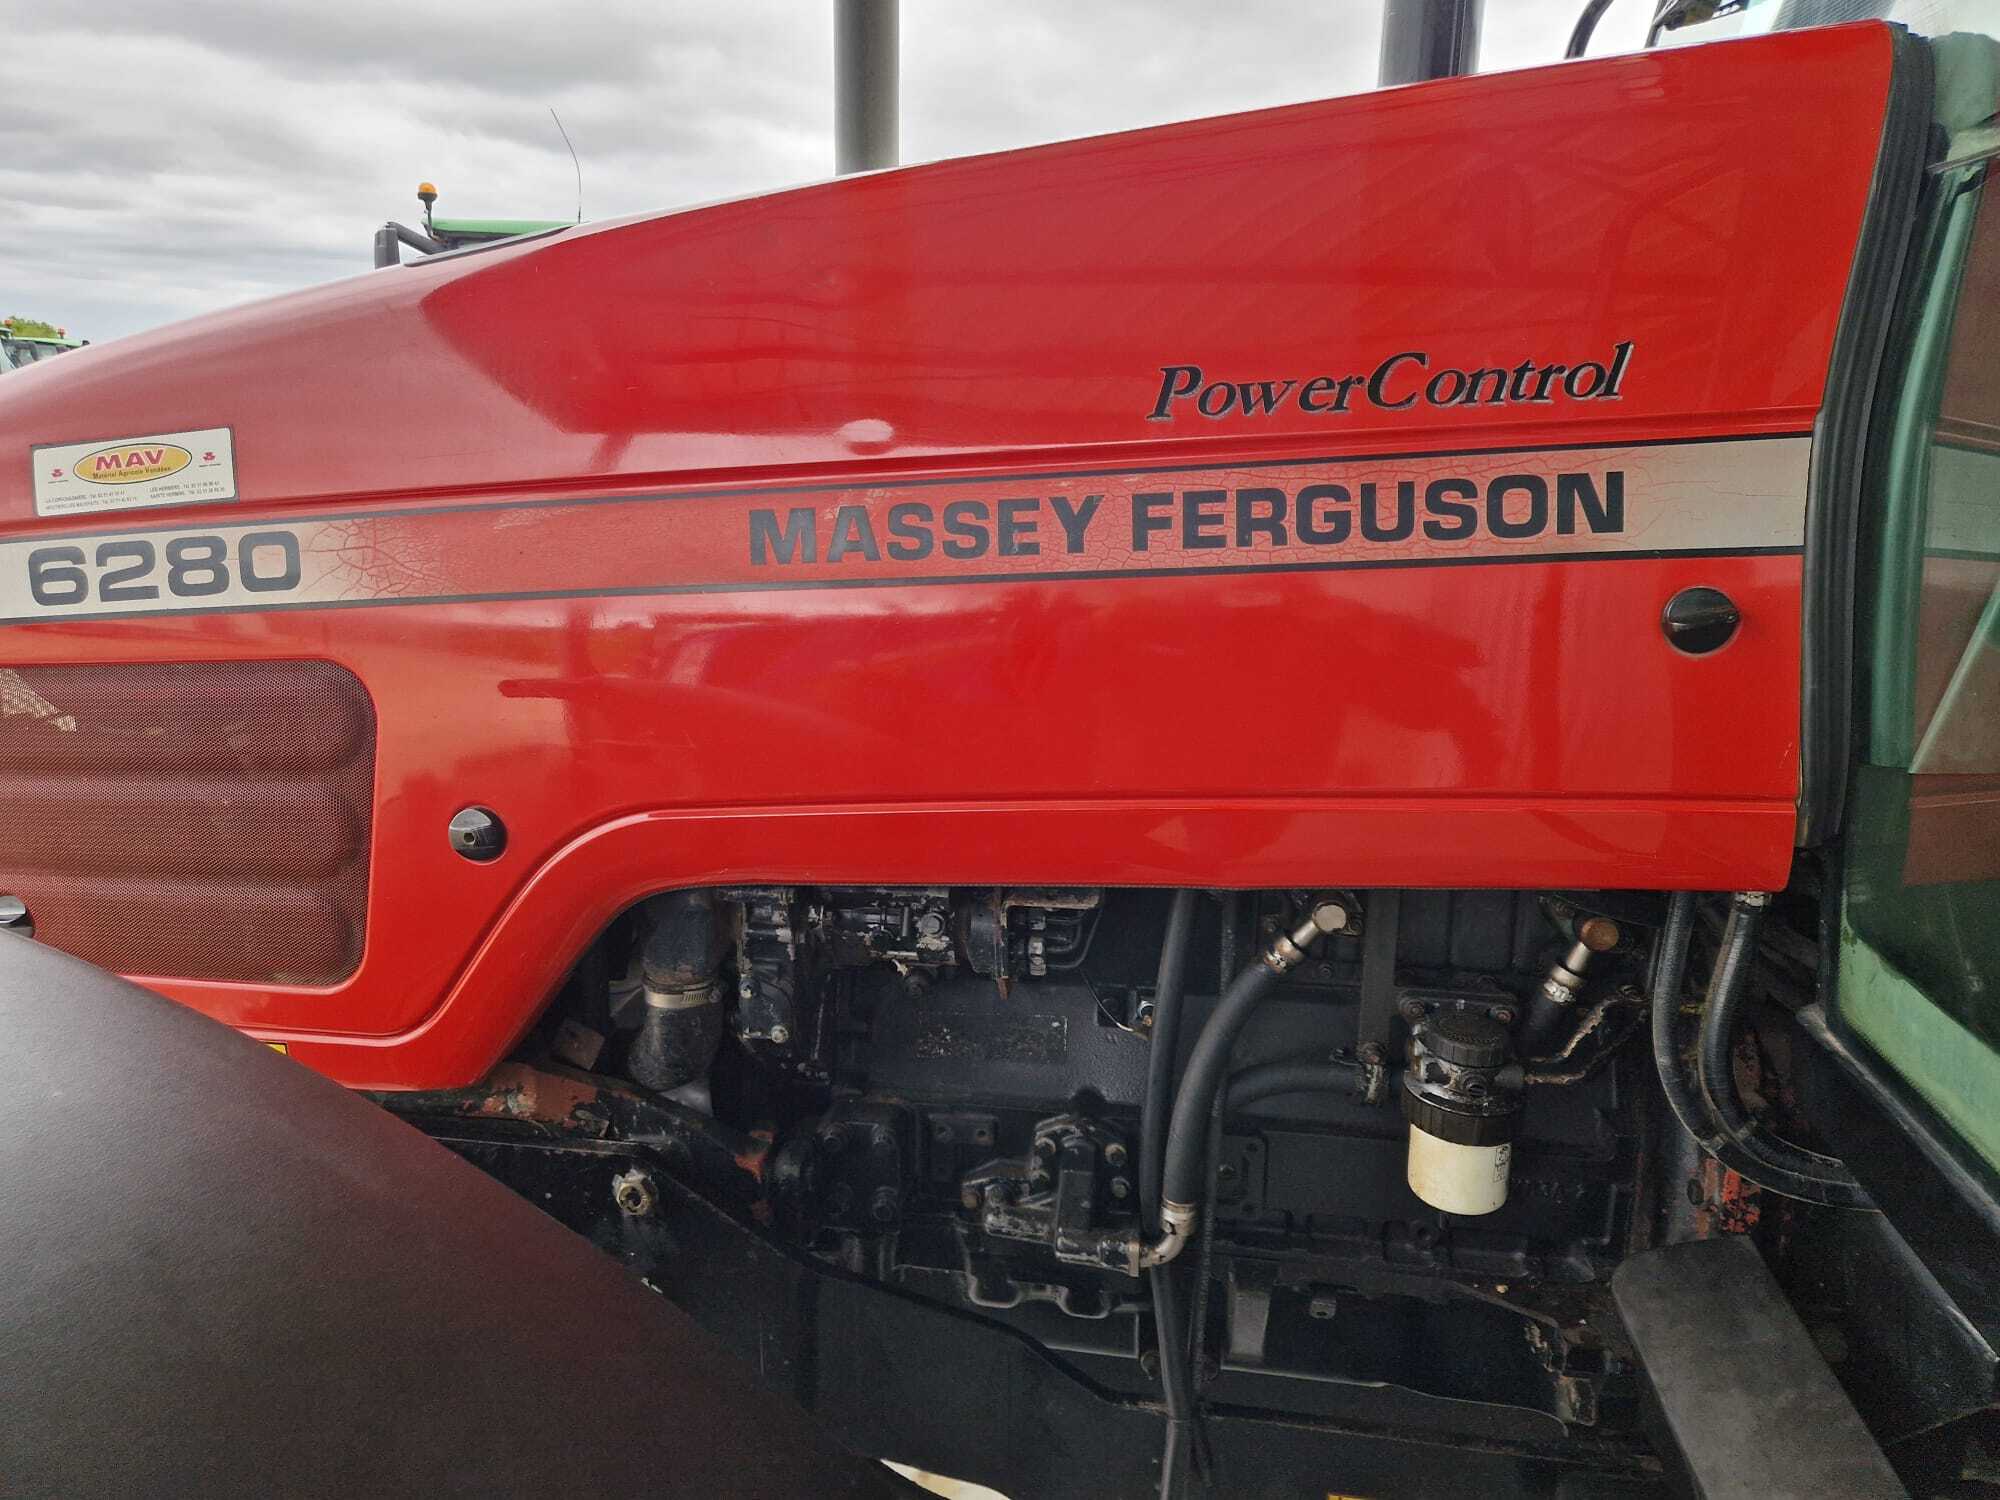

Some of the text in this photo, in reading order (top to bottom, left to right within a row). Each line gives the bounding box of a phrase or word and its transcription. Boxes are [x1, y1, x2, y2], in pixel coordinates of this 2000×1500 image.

[1146, 341, 1634, 423] PowerControl
[95, 448, 165, 472] MAV
[748, 471, 1625, 566] MASSEY FERGUSON
[28, 530, 301, 606] 6280
